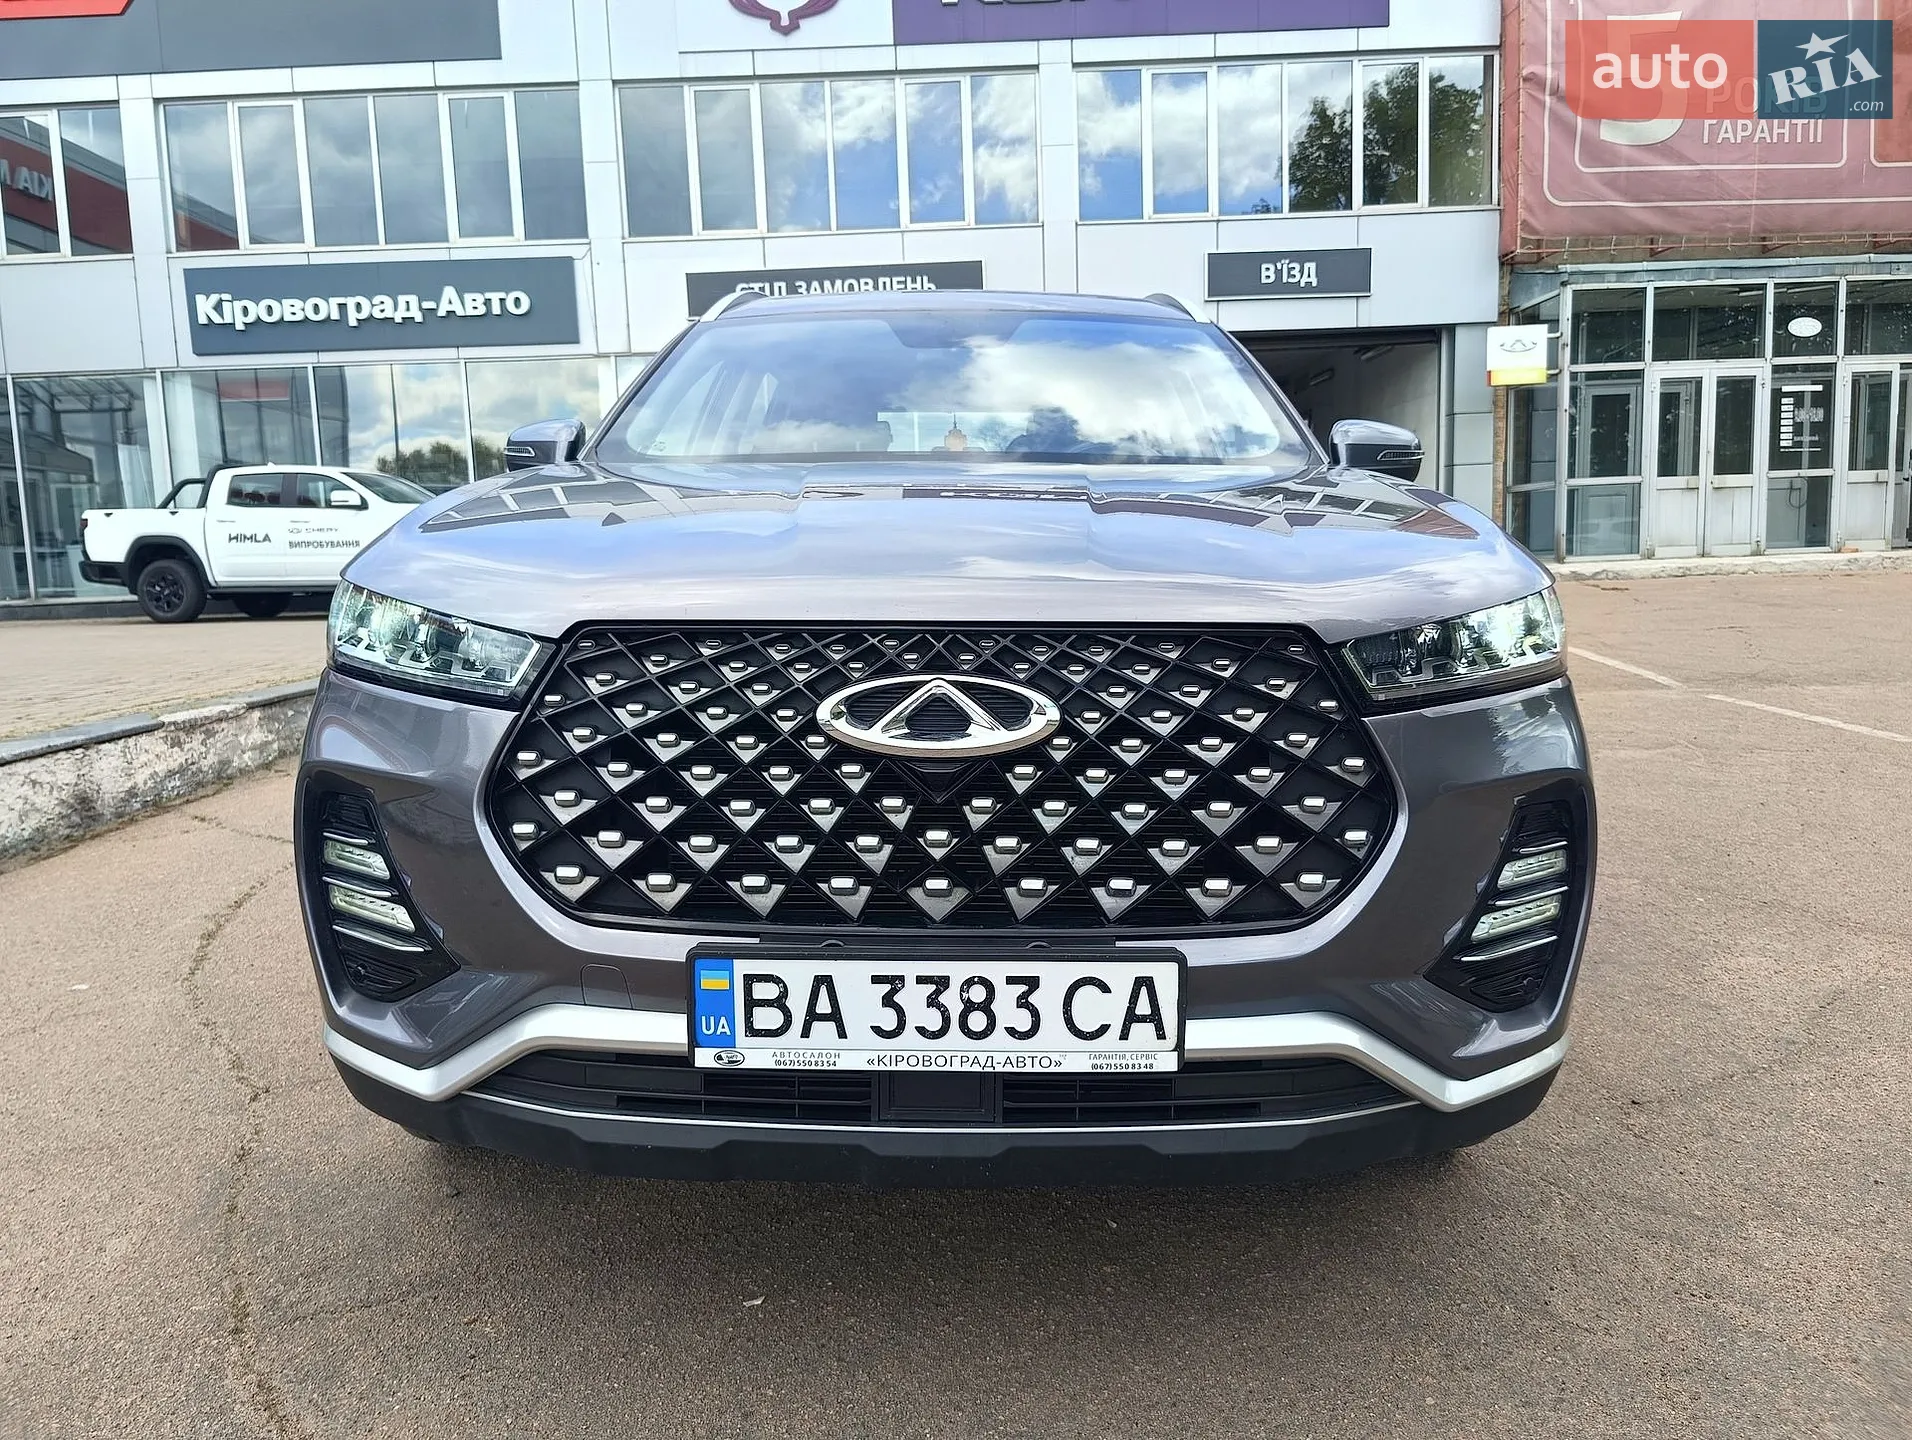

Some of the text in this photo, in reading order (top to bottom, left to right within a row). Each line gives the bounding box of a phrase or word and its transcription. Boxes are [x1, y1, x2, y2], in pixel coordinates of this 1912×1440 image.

[1600, 10, 1688, 146] 5
[1703, 114, 1823, 144] ГАРАНТІЇ
[1261, 260, 1318, 287] В'ЇЗД
[195, 286, 532, 330] Кіровоград-Авто
[289, 540, 361, 549] ВИПРОБУВАННЯ
[743, 974, 1167, 1042] BA 3383 CA
[701, 1015, 731, 1036] UA
[772, 1051, 840, 1059] АВТОСАЛОН
[866, 1054, 1063, 1071] «КІРОВОГРАД-АВТО»
